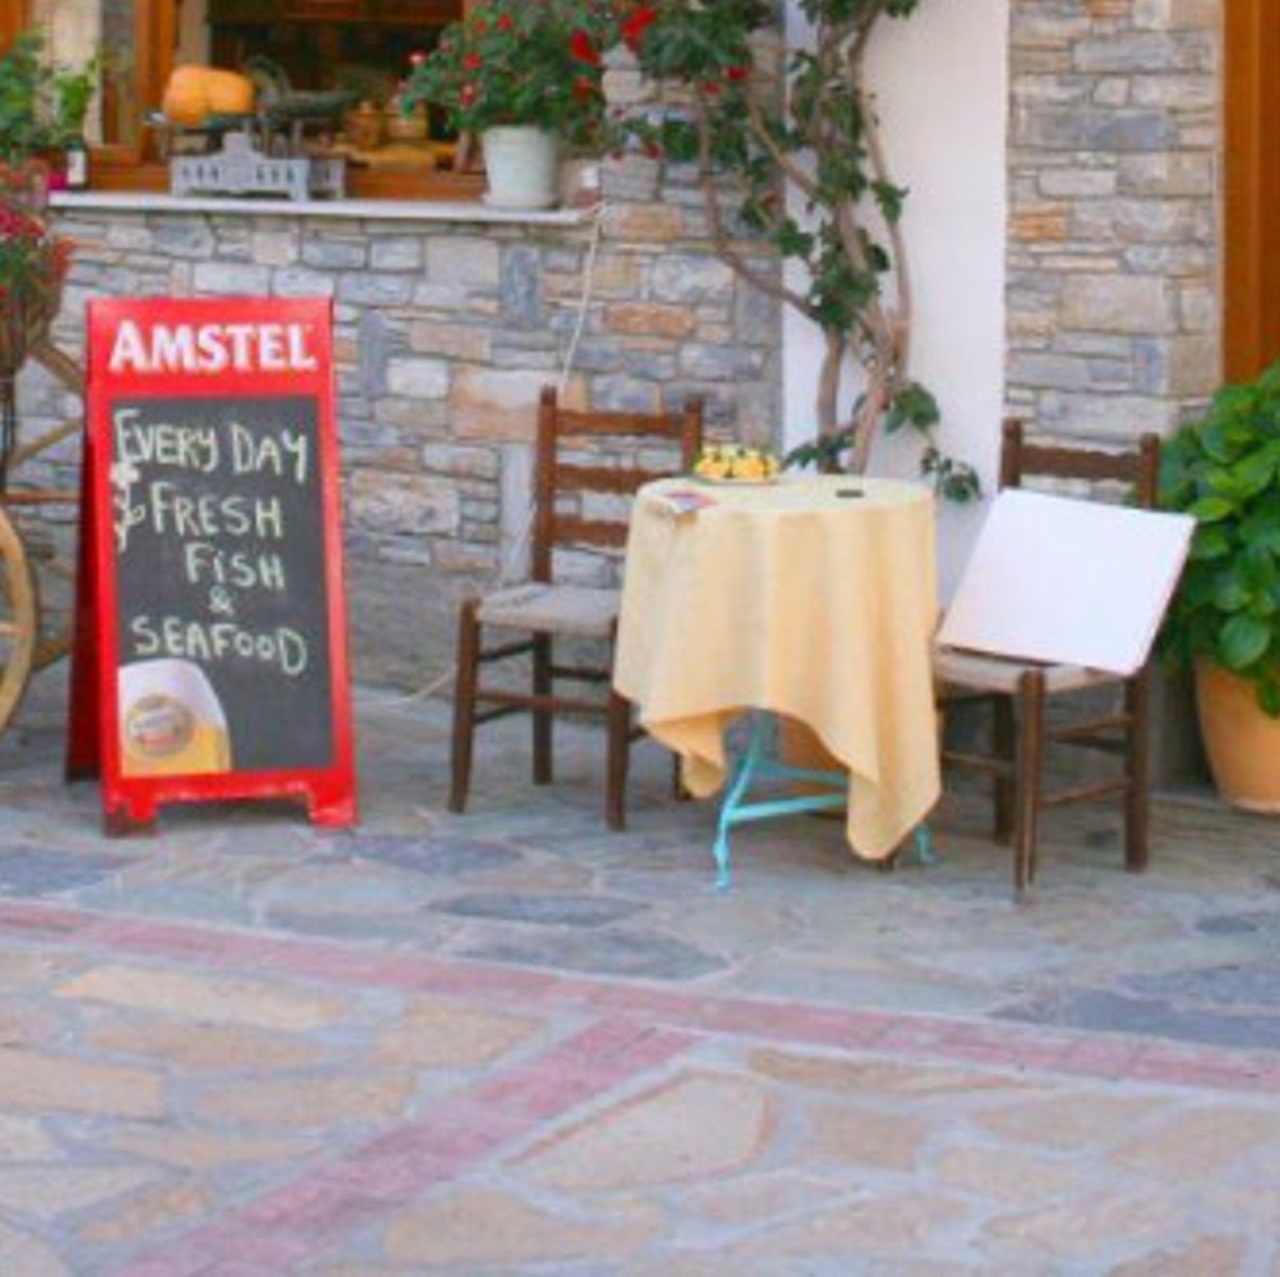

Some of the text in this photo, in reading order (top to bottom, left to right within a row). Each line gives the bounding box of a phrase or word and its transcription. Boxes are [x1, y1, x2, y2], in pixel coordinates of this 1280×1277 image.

[108, 320, 319, 372] AMSTEL
[114, 408, 308, 484] EVERY DAY
[150, 481, 282, 538] FRESH
[208, 584, 235, 616] &
